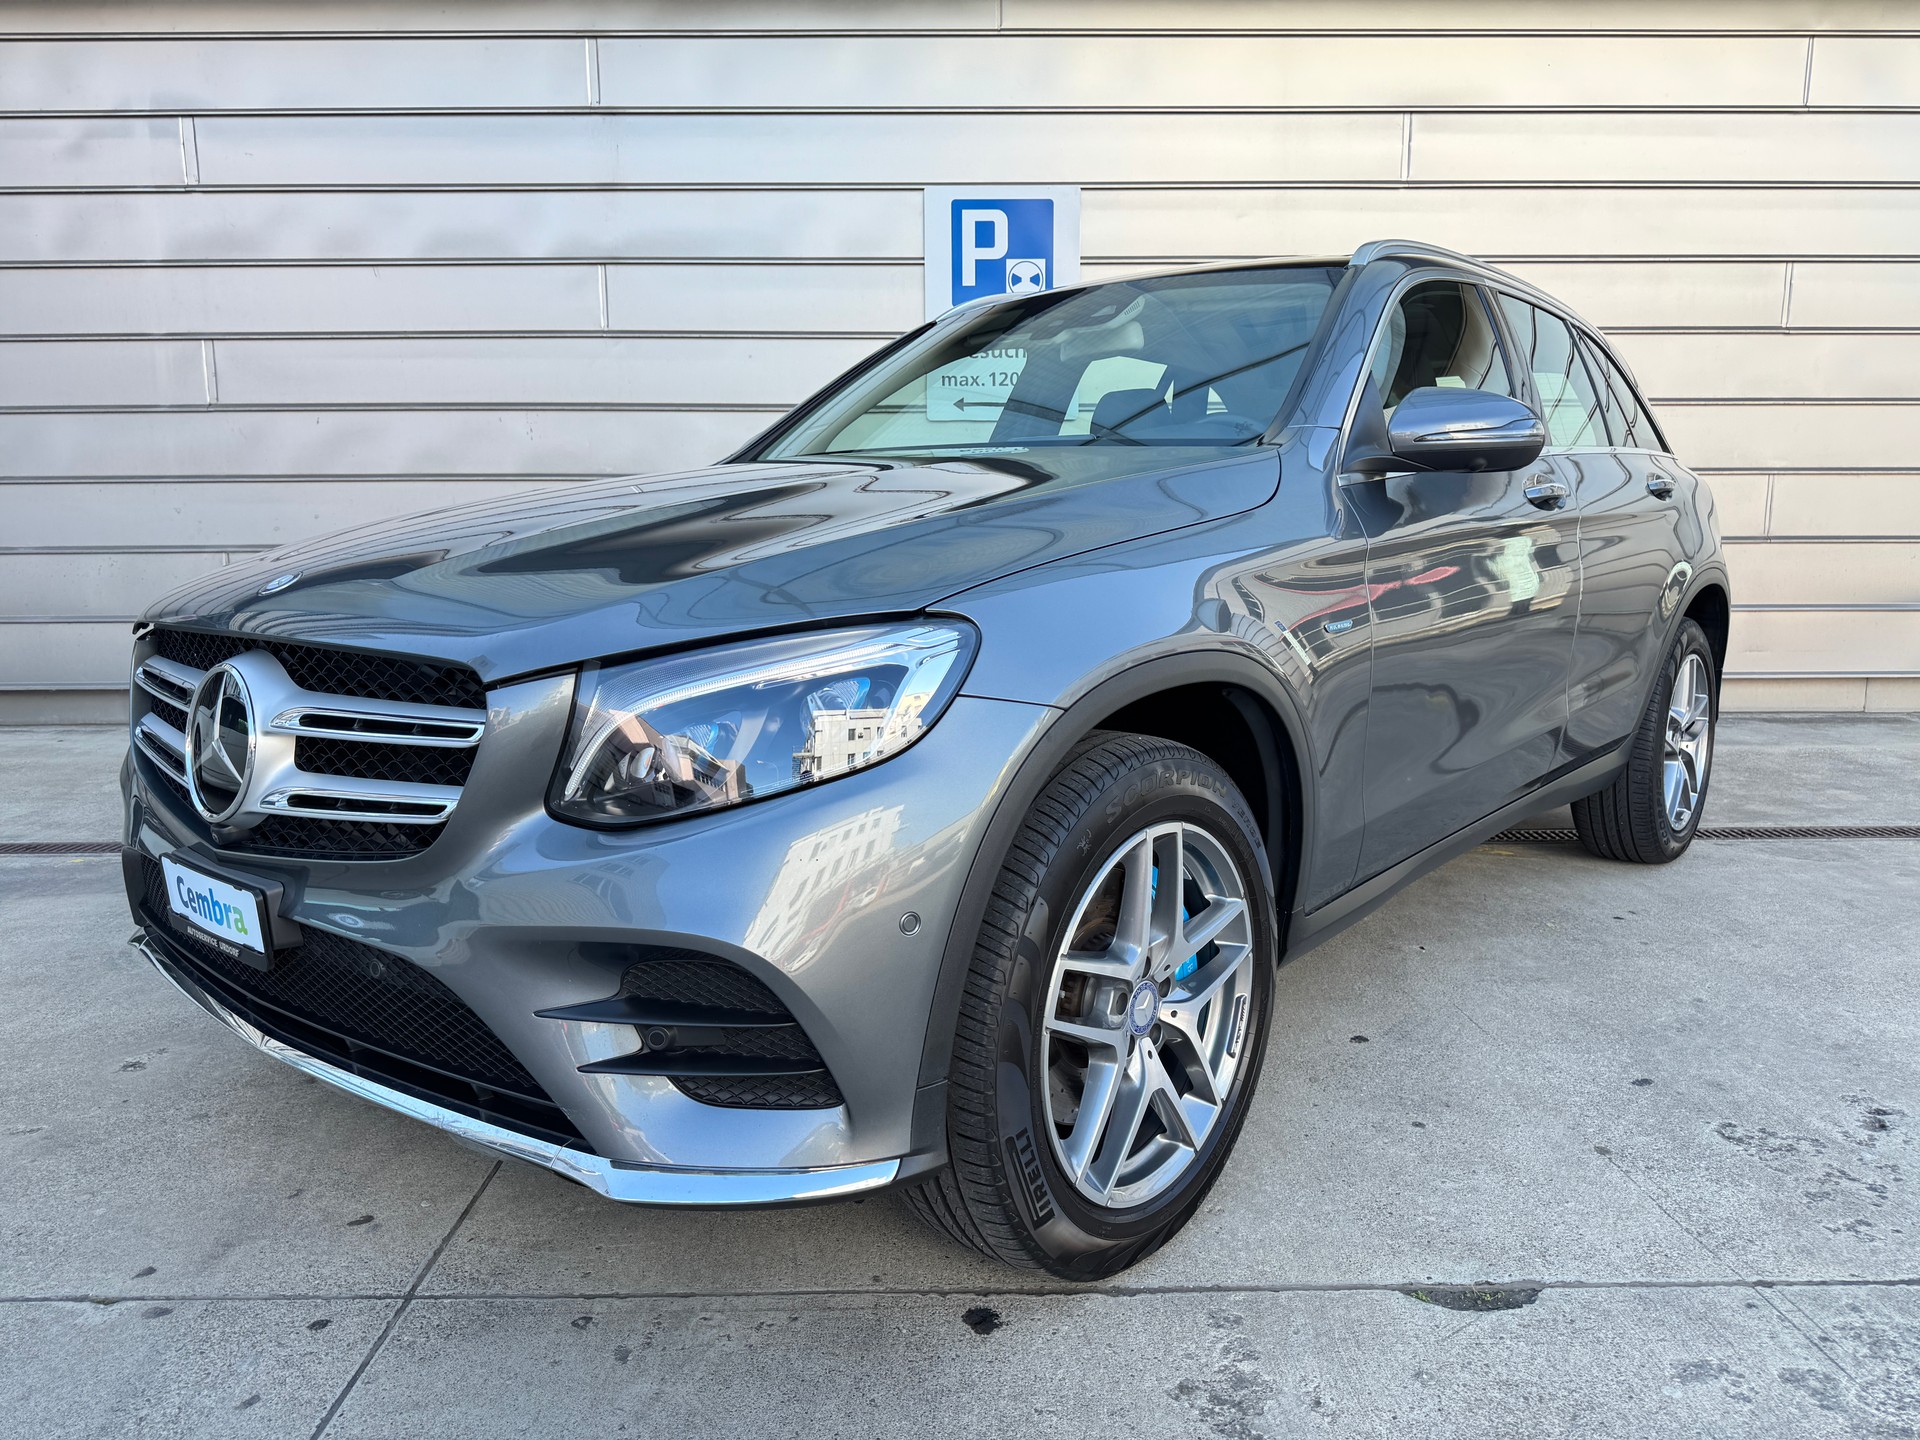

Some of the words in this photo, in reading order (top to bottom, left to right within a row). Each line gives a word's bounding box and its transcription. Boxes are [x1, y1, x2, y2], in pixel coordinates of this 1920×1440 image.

[962, 209, 1008, 287] P
[941, 374, 985, 387] max.
[989, 371, 1020, 387] 120
[1105, 769, 1228, 824] SCORPION
[176, 875, 249, 936] Cembra
[1004, 1125, 1056, 1232] PIRELLI
